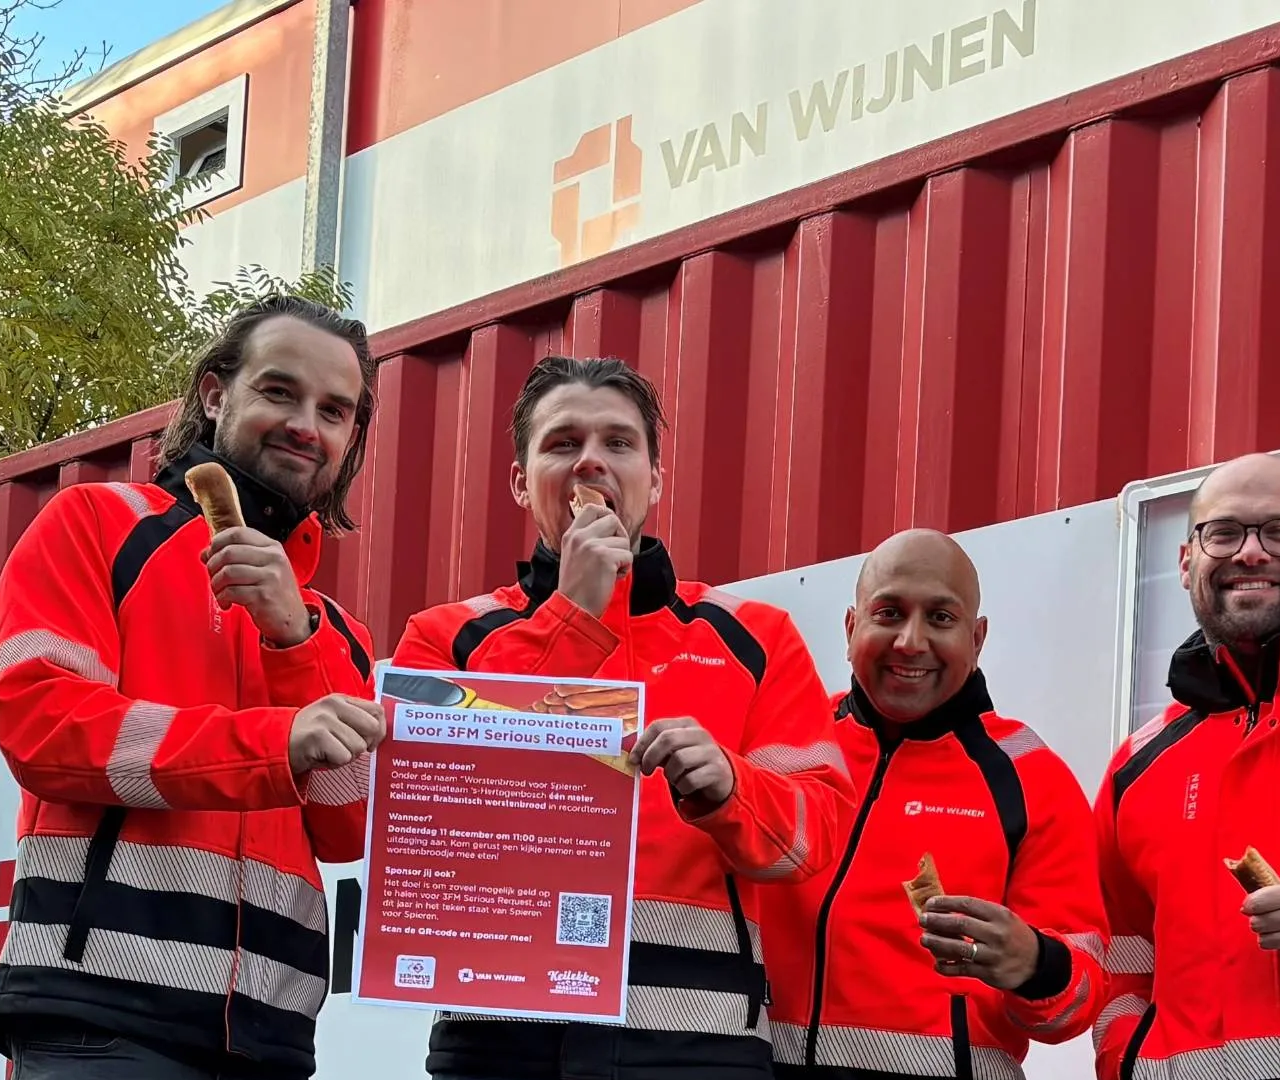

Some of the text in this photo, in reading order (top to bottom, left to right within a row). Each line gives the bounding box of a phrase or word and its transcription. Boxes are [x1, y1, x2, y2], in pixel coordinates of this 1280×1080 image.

[660, 5, 1035, 189] VAN WIJNEN
[405, 709, 612, 732] Sponsor het renovatieteam
[407, 726, 608, 748] voor 3FM Serious Request
[392, 758, 410, 767] Wat
[412, 760, 434, 769] gaan
[449, 762, 476, 771] doen?
[391, 771, 418, 780] Onder
[421, 773, 431, 781] de
[529, 781, 548, 789] voor
[406, 783, 469, 793] renovatieteam
[433, 794, 482, 805] Brabantsch
[484, 799, 547, 810] worstenbrood
[388, 812, 433, 822] Wanneer?
[925, 805, 985, 818] VAN WIJNEN
[387, 825, 437, 836] Donderdag
[440, 828, 447, 836] 11
[449, 829, 493, 839] december
[495, 833, 510, 841] om
[513, 833, 535, 842] 11:00
[537, 836, 557, 844] gaat
[559, 837, 573, 845] het
[576, 839, 597, 847] team
[387, 836, 427, 846] uitdaging
[450, 840, 470, 848] Kom
[472, 841, 500, 850] gerust
[386, 846, 454, 858] worstenbroodje
[456, 851, 475, 859] mee
[385, 866, 456, 878] Sponsor jij ook?
[384, 879, 400, 887] Het
[402, 880, 421, 889] doel
[423, 881, 430, 889] is
[449, 884, 476, 892] zoveel
[478, 886, 515, 896] mogelijk
[517, 888, 537, 897] geld
[383, 889, 392, 897] te
[394, 890, 418, 899] halen
[443, 893, 461, 901] 3FM
[463, 894, 495, 904] Serious
[537, 899, 552, 908] dat
[383, 900, 394, 908] dit
[396, 900, 413, 909] jaar
[415, 901, 423, 909] in
[425, 902, 440, 910] het
[442, 903, 466, 912] teken
[509, 907, 542, 917] Spieren
[381, 925, 402, 933] Scan
[404, 926, 416, 934] de
[418, 927, 457, 937] QR-code
[459, 930, 470, 938] en
[472, 931, 509, 940] sponsor
